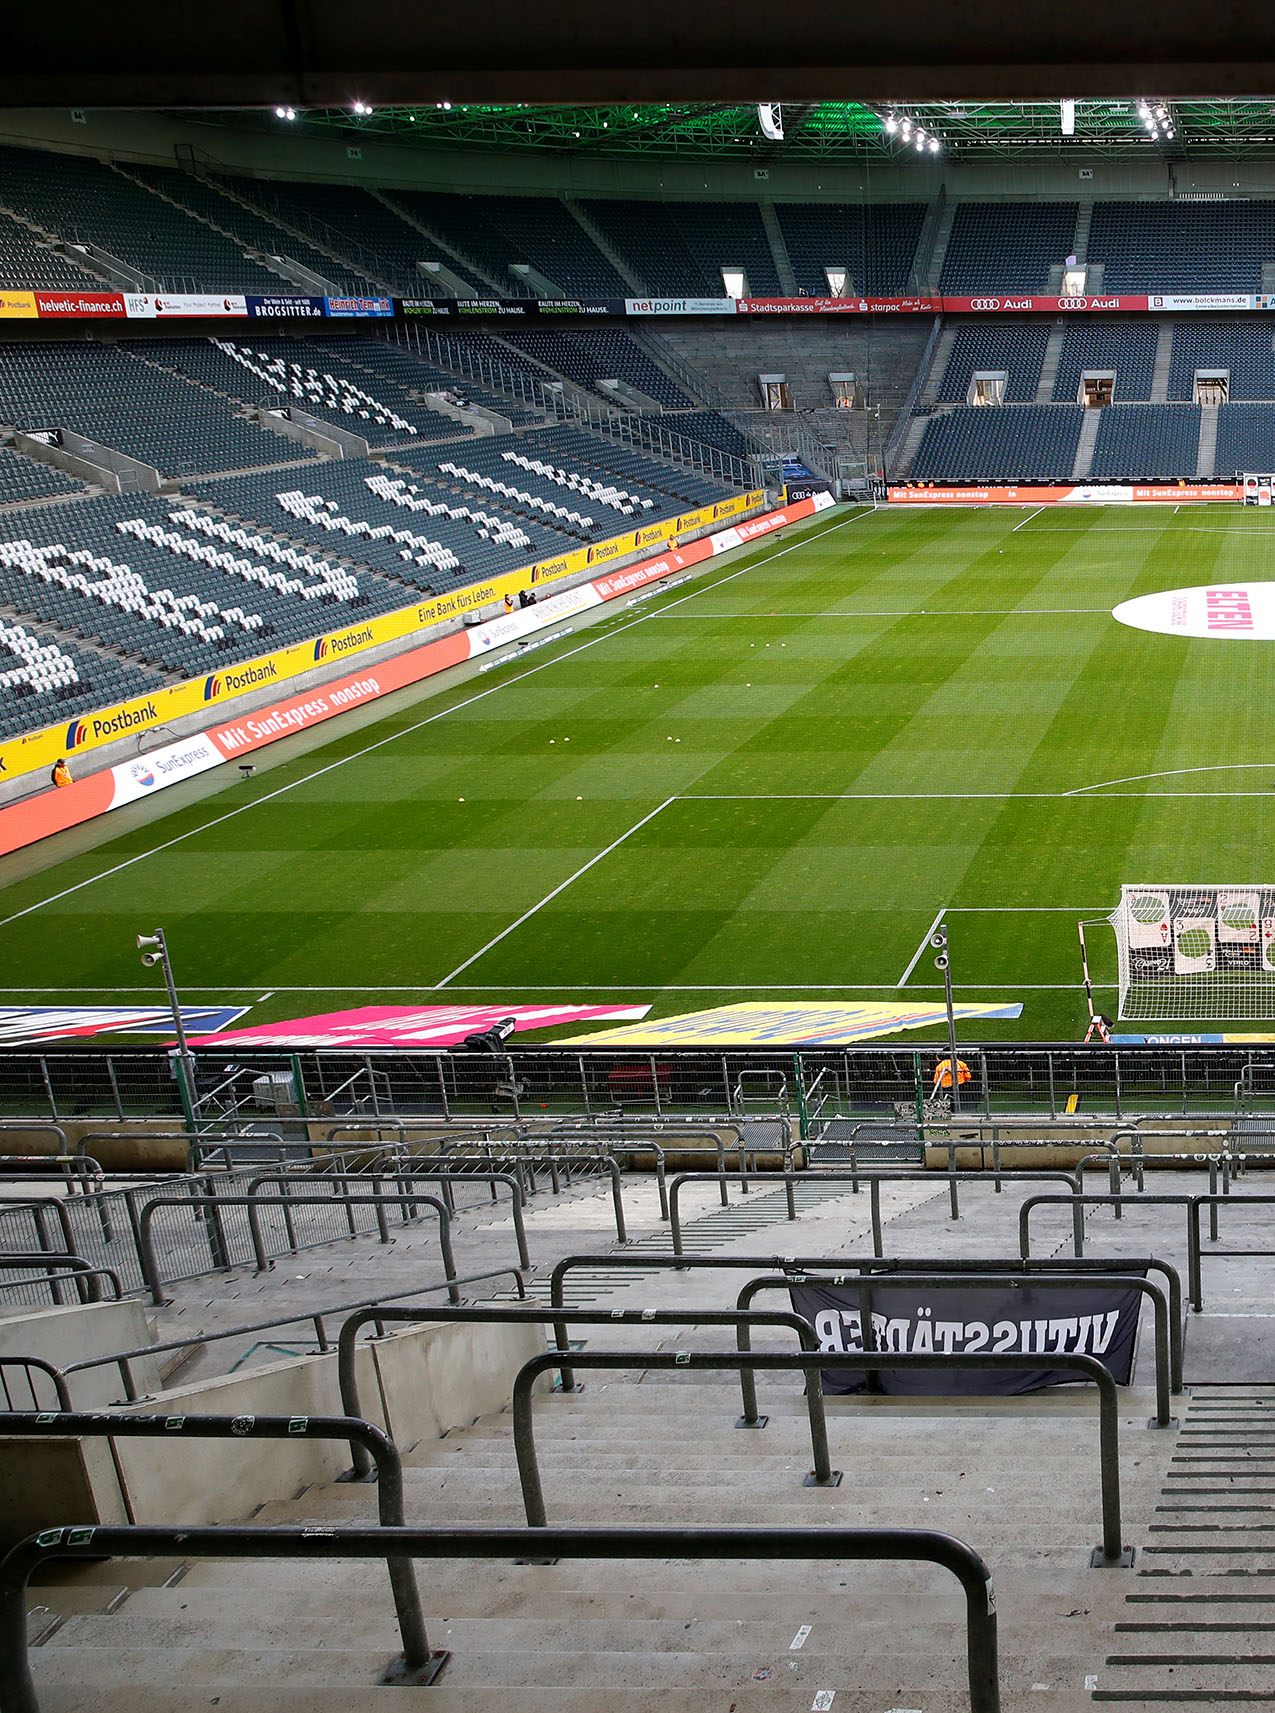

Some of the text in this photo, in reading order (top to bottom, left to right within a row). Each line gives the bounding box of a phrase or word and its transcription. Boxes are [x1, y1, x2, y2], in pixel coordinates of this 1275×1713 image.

[39, 299, 123, 313] helvetic-finance.ch
[128, 298, 145, 312] HFS
[632, 300, 686, 313] netpoint
[750, 303, 814, 313] Stadtsparkasse
[870, 303, 901, 312] starpac
[1003, 299, 1032, 309] Audi
[1091, 299, 1120, 308] Audi
[255, 306, 321, 317] BROGSITTER.de
[909, 490, 955, 499] SunExpress
[1152, 489, 1198, 498] SunExpress
[1201, 490, 1234, 498] nonstop
[541, 560, 568, 577] Postbank
[596, 581, 611, 596] Mit
[609, 571, 647, 591] SunExpress
[418, 587, 497, 622] Eine Bank fürs Leben.
[1206, 591, 1254, 630] ELTEN
[331, 626, 374, 653] Postbank
[225, 660, 277, 691] Postbank
[93, 701, 158, 738] Postbank
[217, 677, 380, 751] Mit SunExpress nonstop
[155, 746, 210, 774] SunExpress
[1176, 920, 1184, 930] 3
